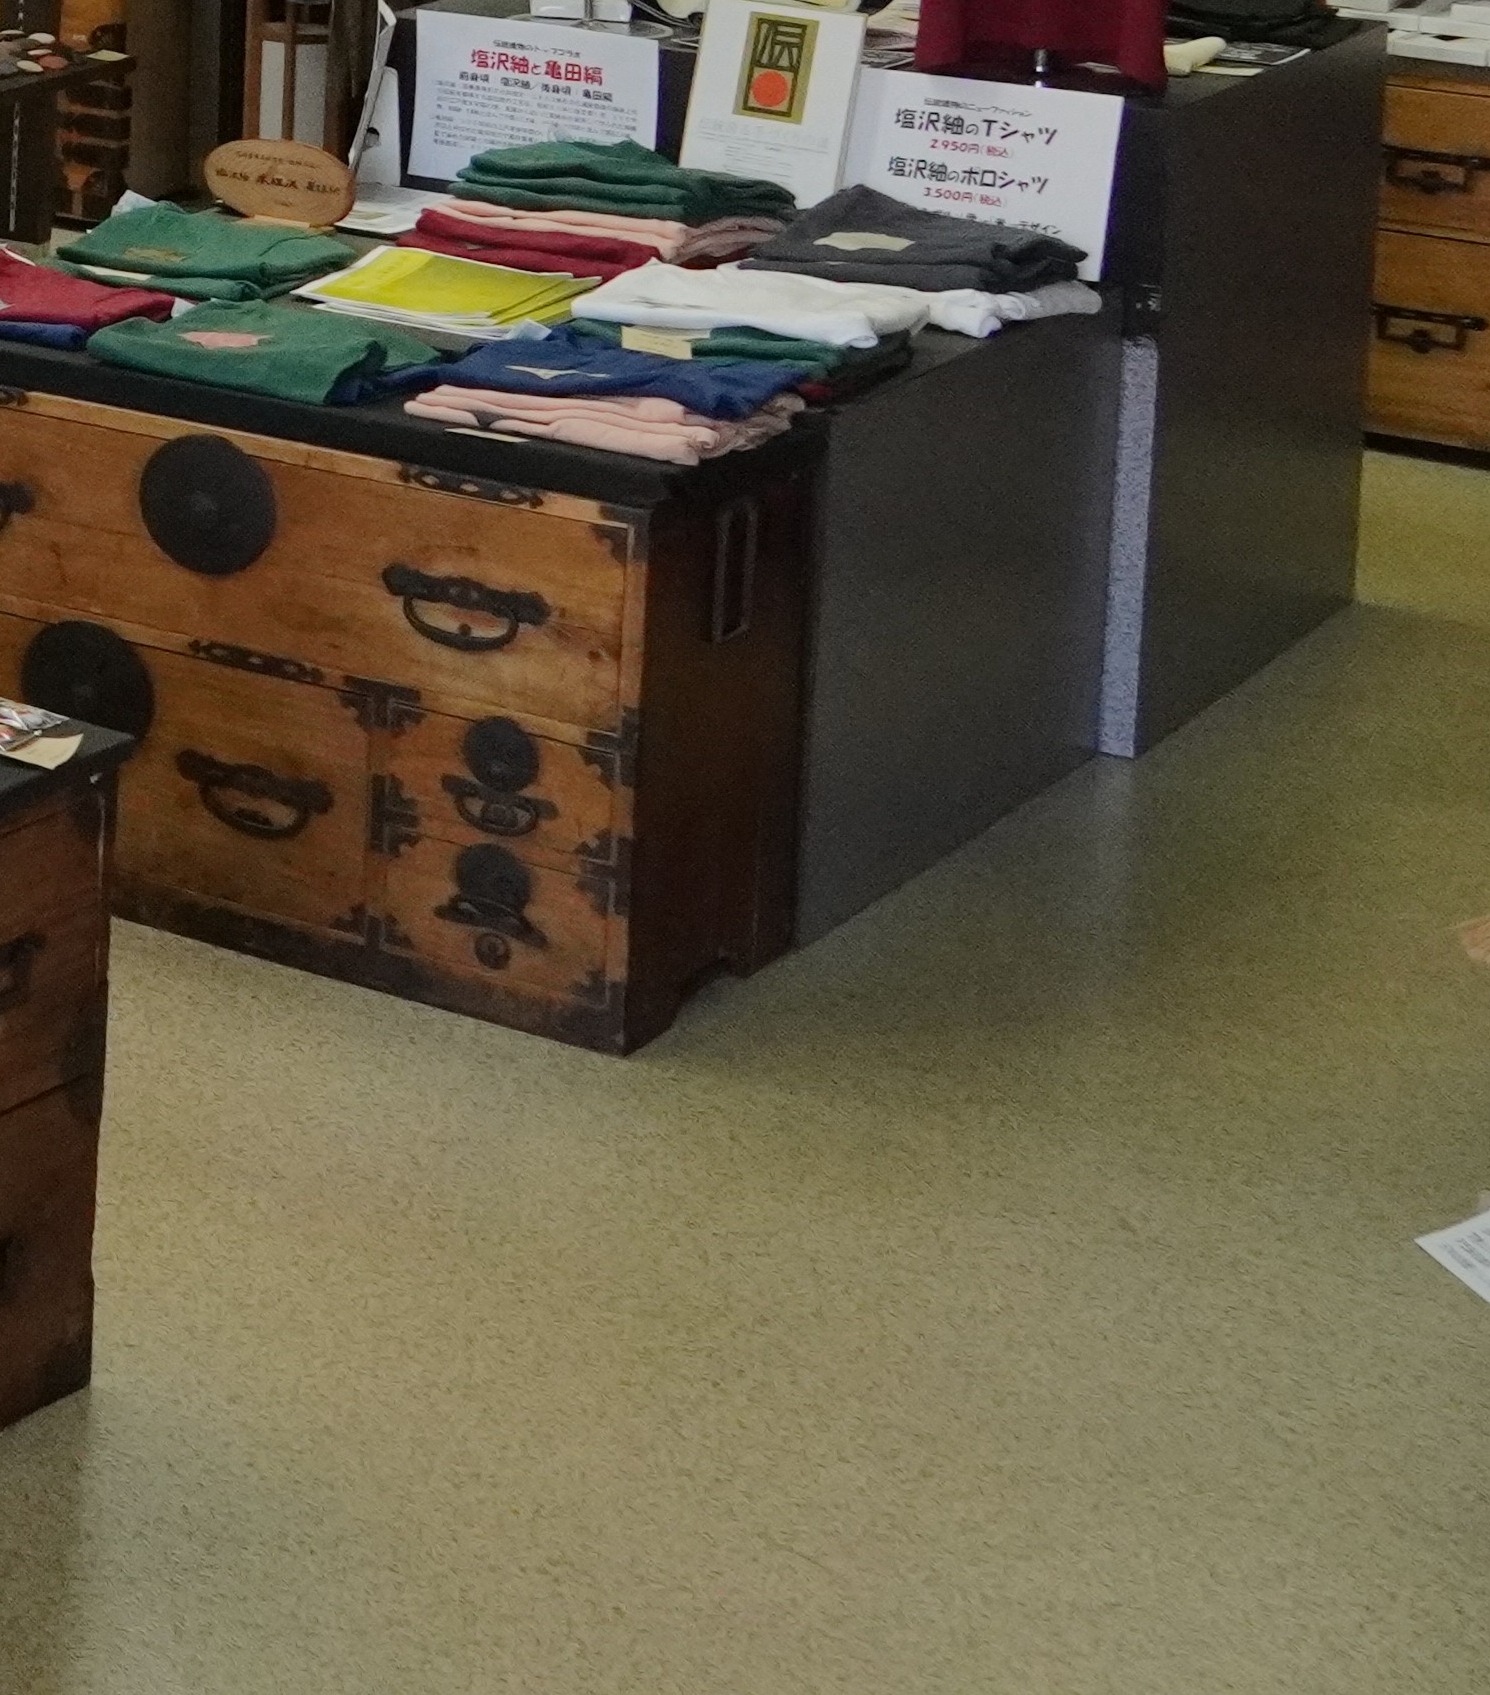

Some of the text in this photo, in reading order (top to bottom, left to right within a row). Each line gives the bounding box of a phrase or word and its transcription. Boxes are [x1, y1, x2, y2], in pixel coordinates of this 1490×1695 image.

[471, 48, 604, 87] 塩沢紬と亀田縞
[895, 107, 1059, 146] 塩沢紬のTシャツ
[887, 155, 1050, 194] 塩沢紬のポロシャツ
